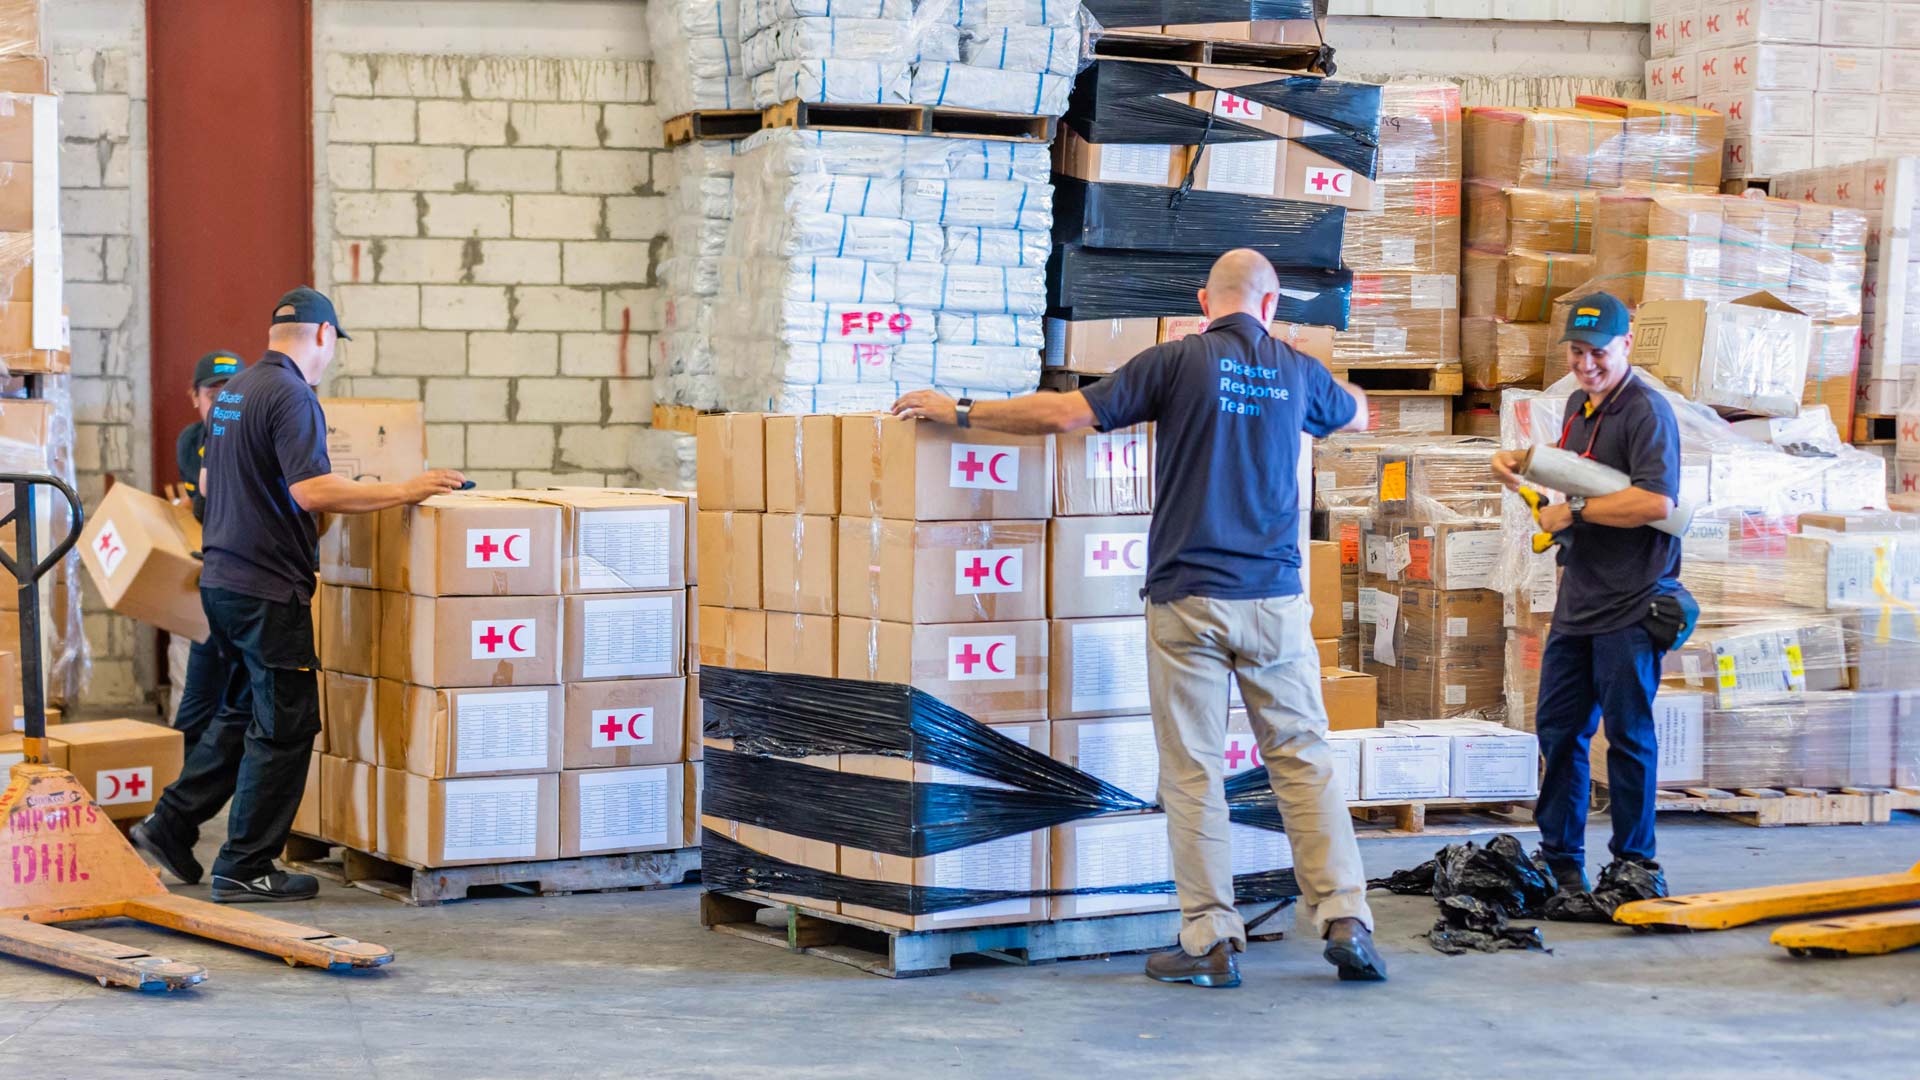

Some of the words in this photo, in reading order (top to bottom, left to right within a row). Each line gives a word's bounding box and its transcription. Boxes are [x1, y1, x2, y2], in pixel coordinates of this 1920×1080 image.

[1574, 315, 1599, 327] DRT
[1220, 358, 1278, 379] Disaster
[1220, 377, 1289, 400] Response
[1219, 396, 1260, 417] Team
[9, 804, 97, 834] IMPORTS
[12, 843, 90, 884] DHL
